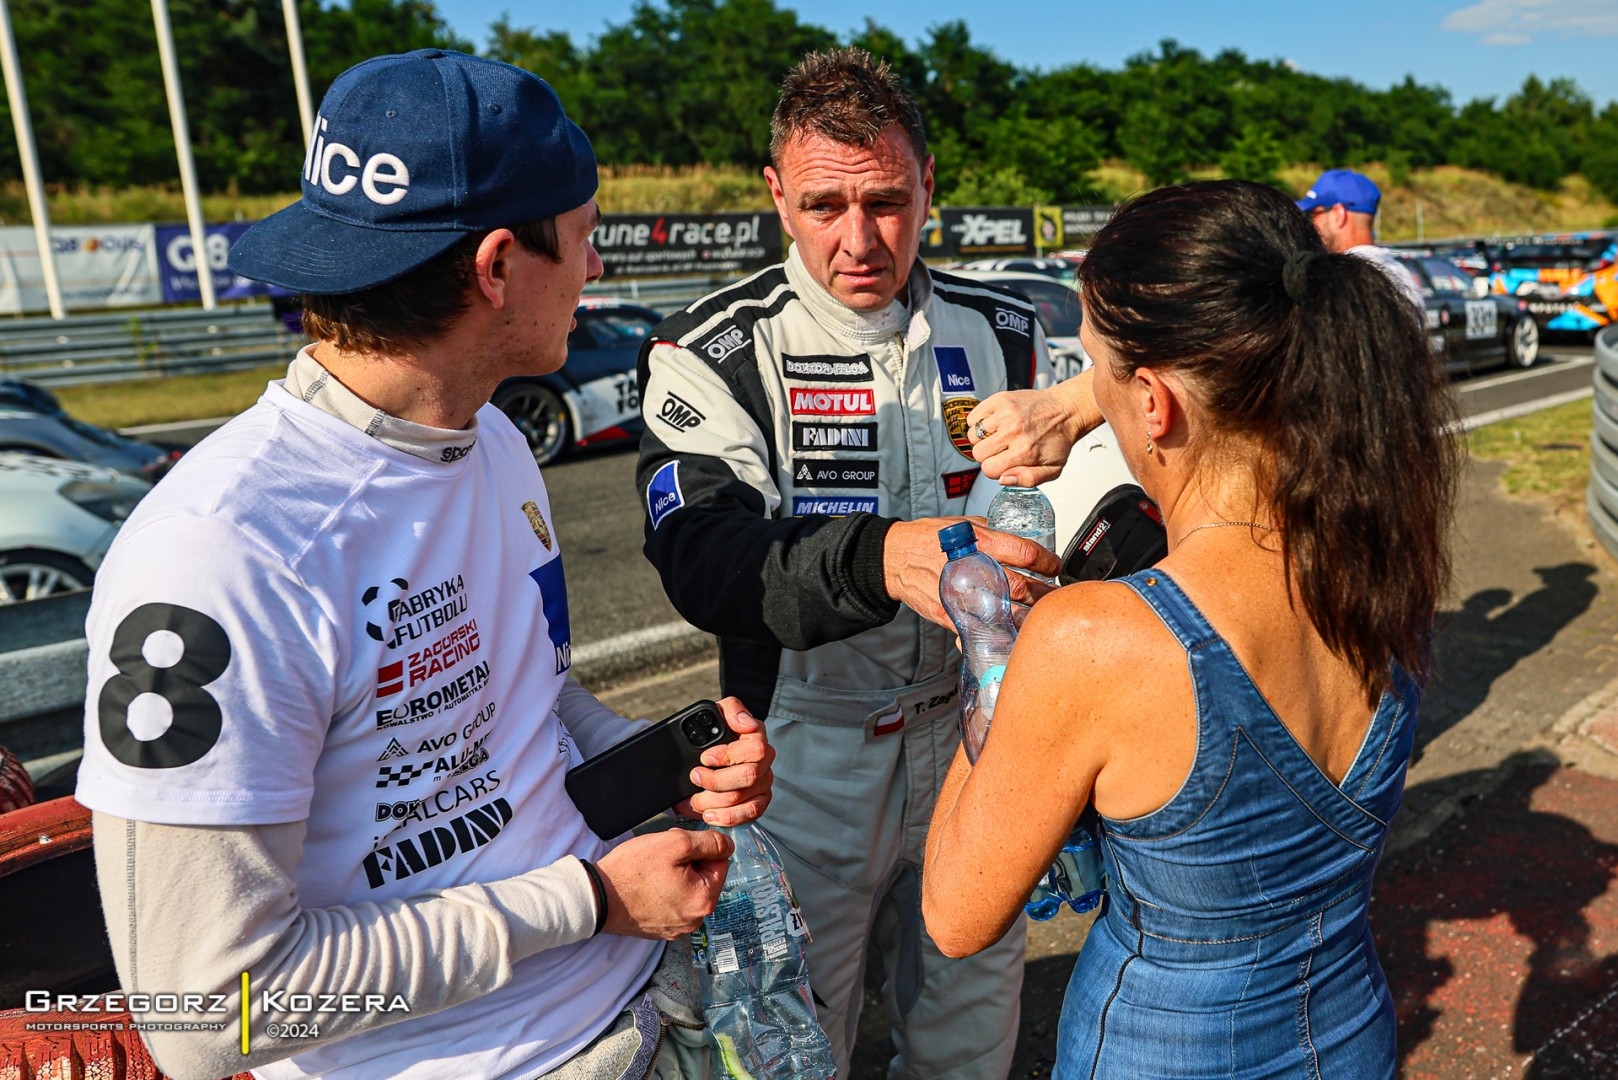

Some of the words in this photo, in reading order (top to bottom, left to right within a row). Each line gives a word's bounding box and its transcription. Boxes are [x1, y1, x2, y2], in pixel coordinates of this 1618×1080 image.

[960, 214, 1027, 246] XPEL
[167, 233, 230, 271] Q8
[996, 311, 1030, 331] OMP
[707, 328, 744, 359] OMP
[947, 374, 971, 387] Nice
[661, 398, 701, 428] OMP
[794, 392, 873, 412] MOTUL
[943, 400, 981, 411] PORSCH
[803, 427, 869, 447] FADINI
[816, 470, 838, 480] AVO
[842, 470, 876, 480] GROUP
[655, 492, 676, 515] Nice
[796, 502, 875, 514] MICHELIN
[394, 593, 468, 647] FUTBOLU
[409, 632, 481, 688] RACING
[556, 641, 572, 672] Ni
[98, 602, 232, 769] 8
[376, 660, 491, 727] EUROMETAL
[914, 701, 926, 715] T.
[417, 732, 457, 753] AVO
[751, 883, 785, 943] PILSKO
